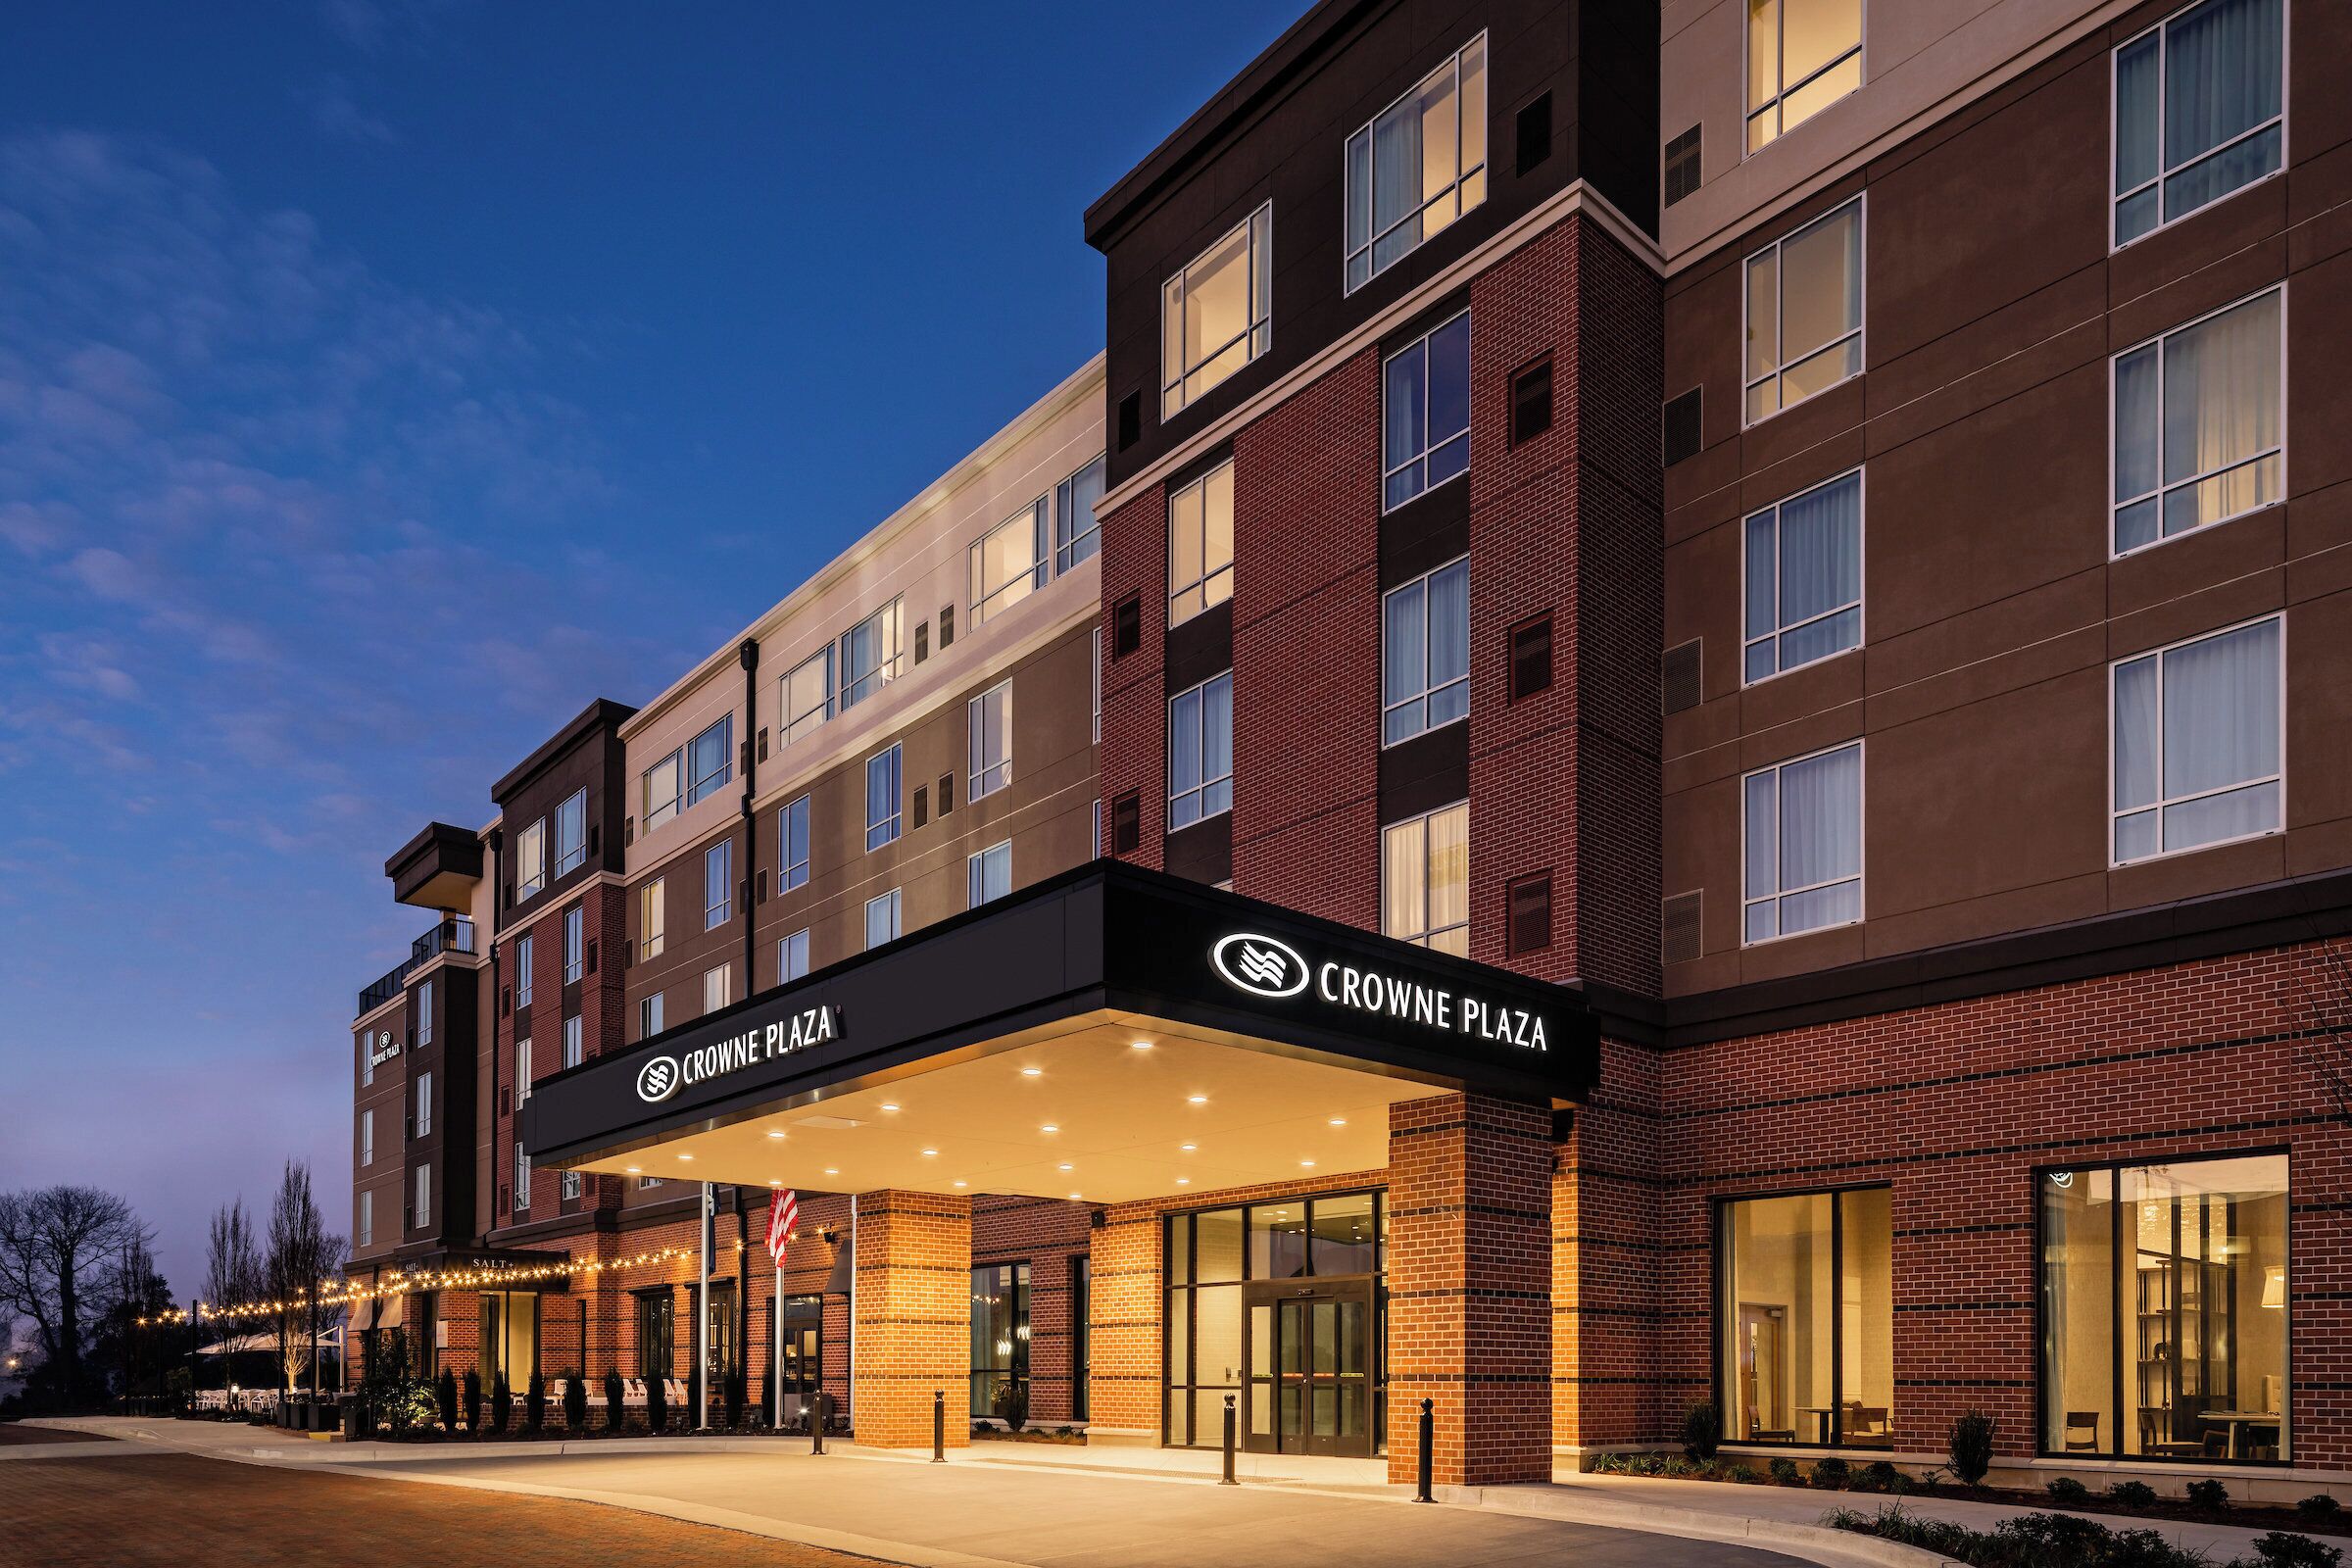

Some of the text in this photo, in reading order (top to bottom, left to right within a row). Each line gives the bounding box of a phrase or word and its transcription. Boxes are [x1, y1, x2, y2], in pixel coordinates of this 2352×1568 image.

[683, 1004, 831, 1085] CROWNE PLAZA
[1320, 961, 1548, 1052] CROWNE PLAZA
[370, 1043, 401, 1068] CROWNE PLAZA
